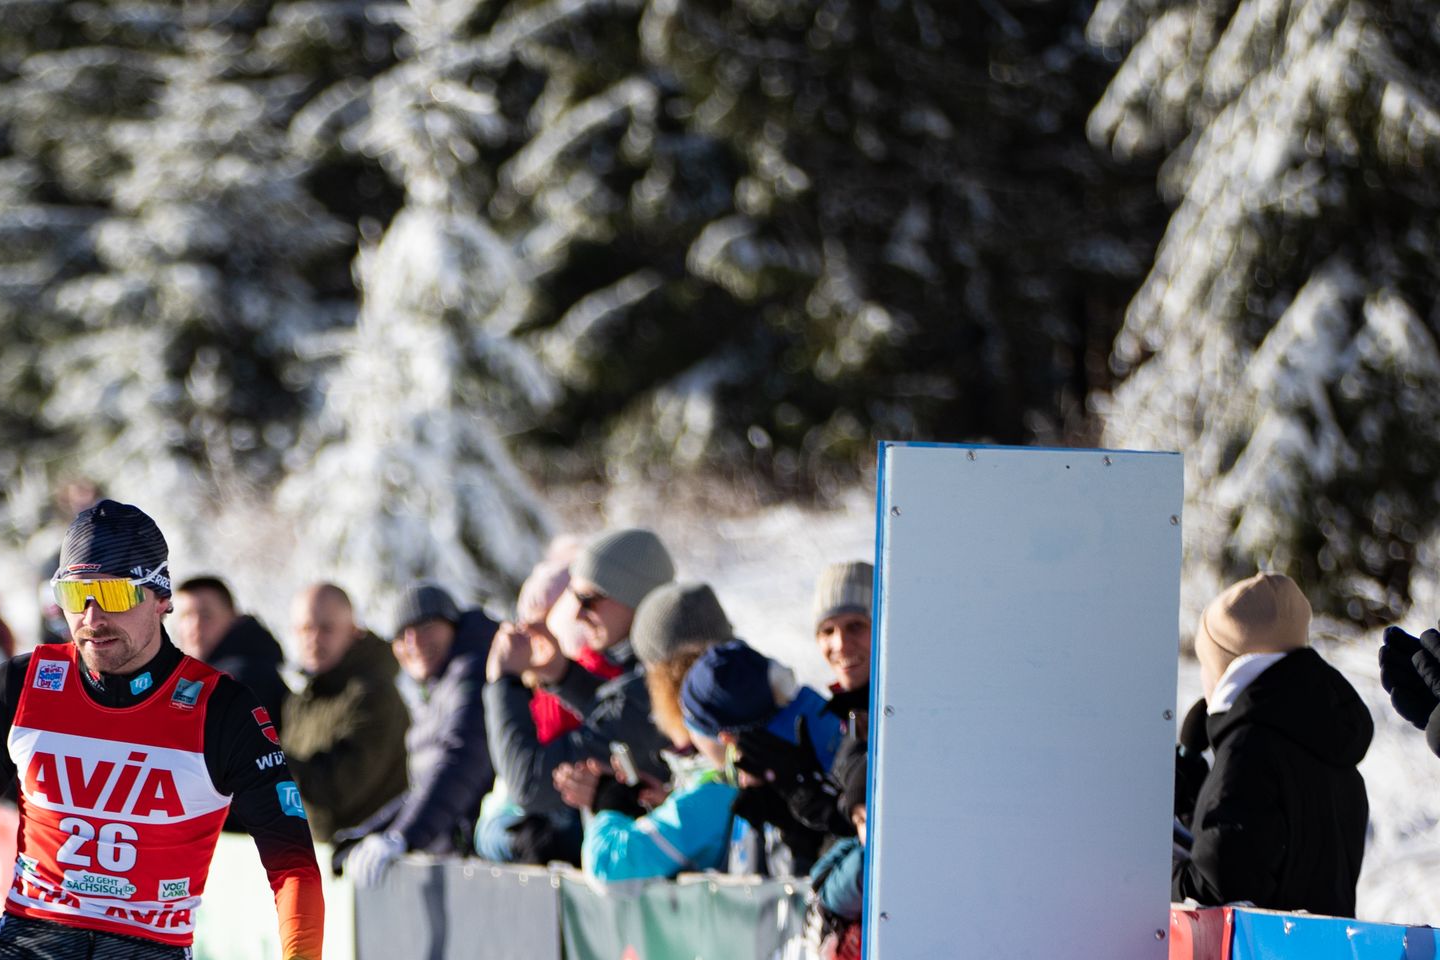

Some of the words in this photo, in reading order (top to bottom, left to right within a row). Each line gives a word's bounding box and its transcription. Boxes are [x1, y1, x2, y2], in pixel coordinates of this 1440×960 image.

[56, 817, 139, 873] 26
[83, 874, 95, 883] SO
[96, 876, 119, 887] GEHT
[162, 880, 187, 891] VOGT
